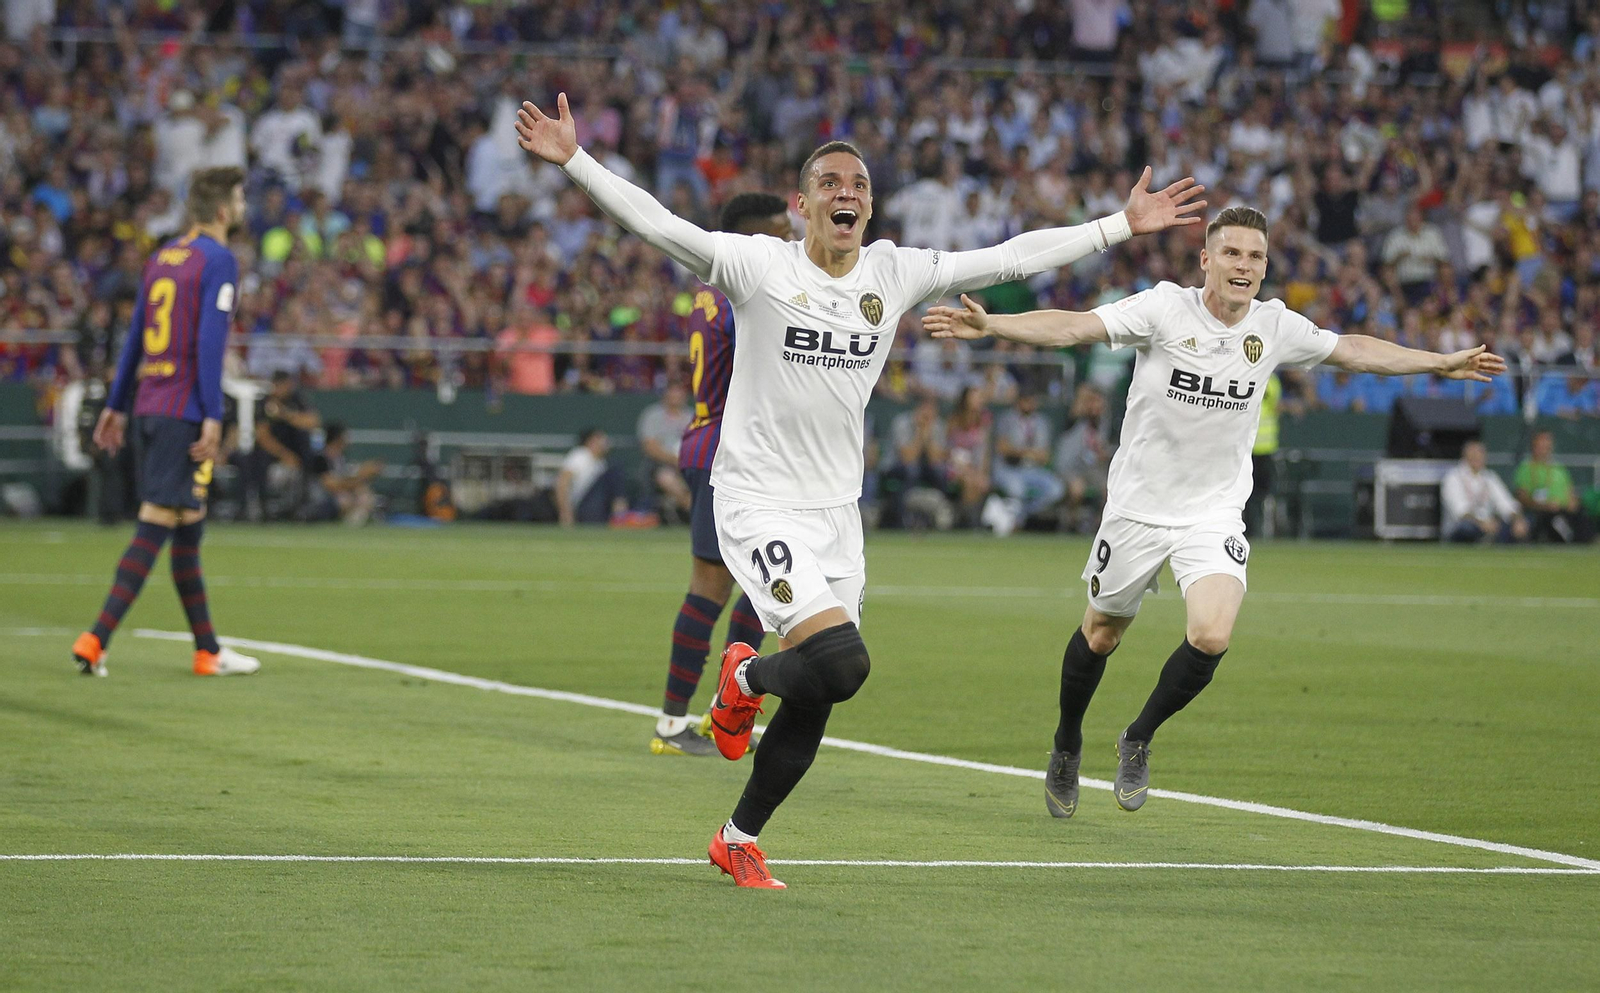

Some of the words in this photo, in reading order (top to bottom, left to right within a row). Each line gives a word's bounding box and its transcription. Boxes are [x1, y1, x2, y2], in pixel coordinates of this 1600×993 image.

[144, 277, 177, 356] 3
[788, 298, 811, 310] adidas
[782, 350, 871, 370] smartphones
[1166, 388, 1249, 411] smartphones
[751, 540, 793, 586] 19
[1096, 539, 1112, 574] 9
